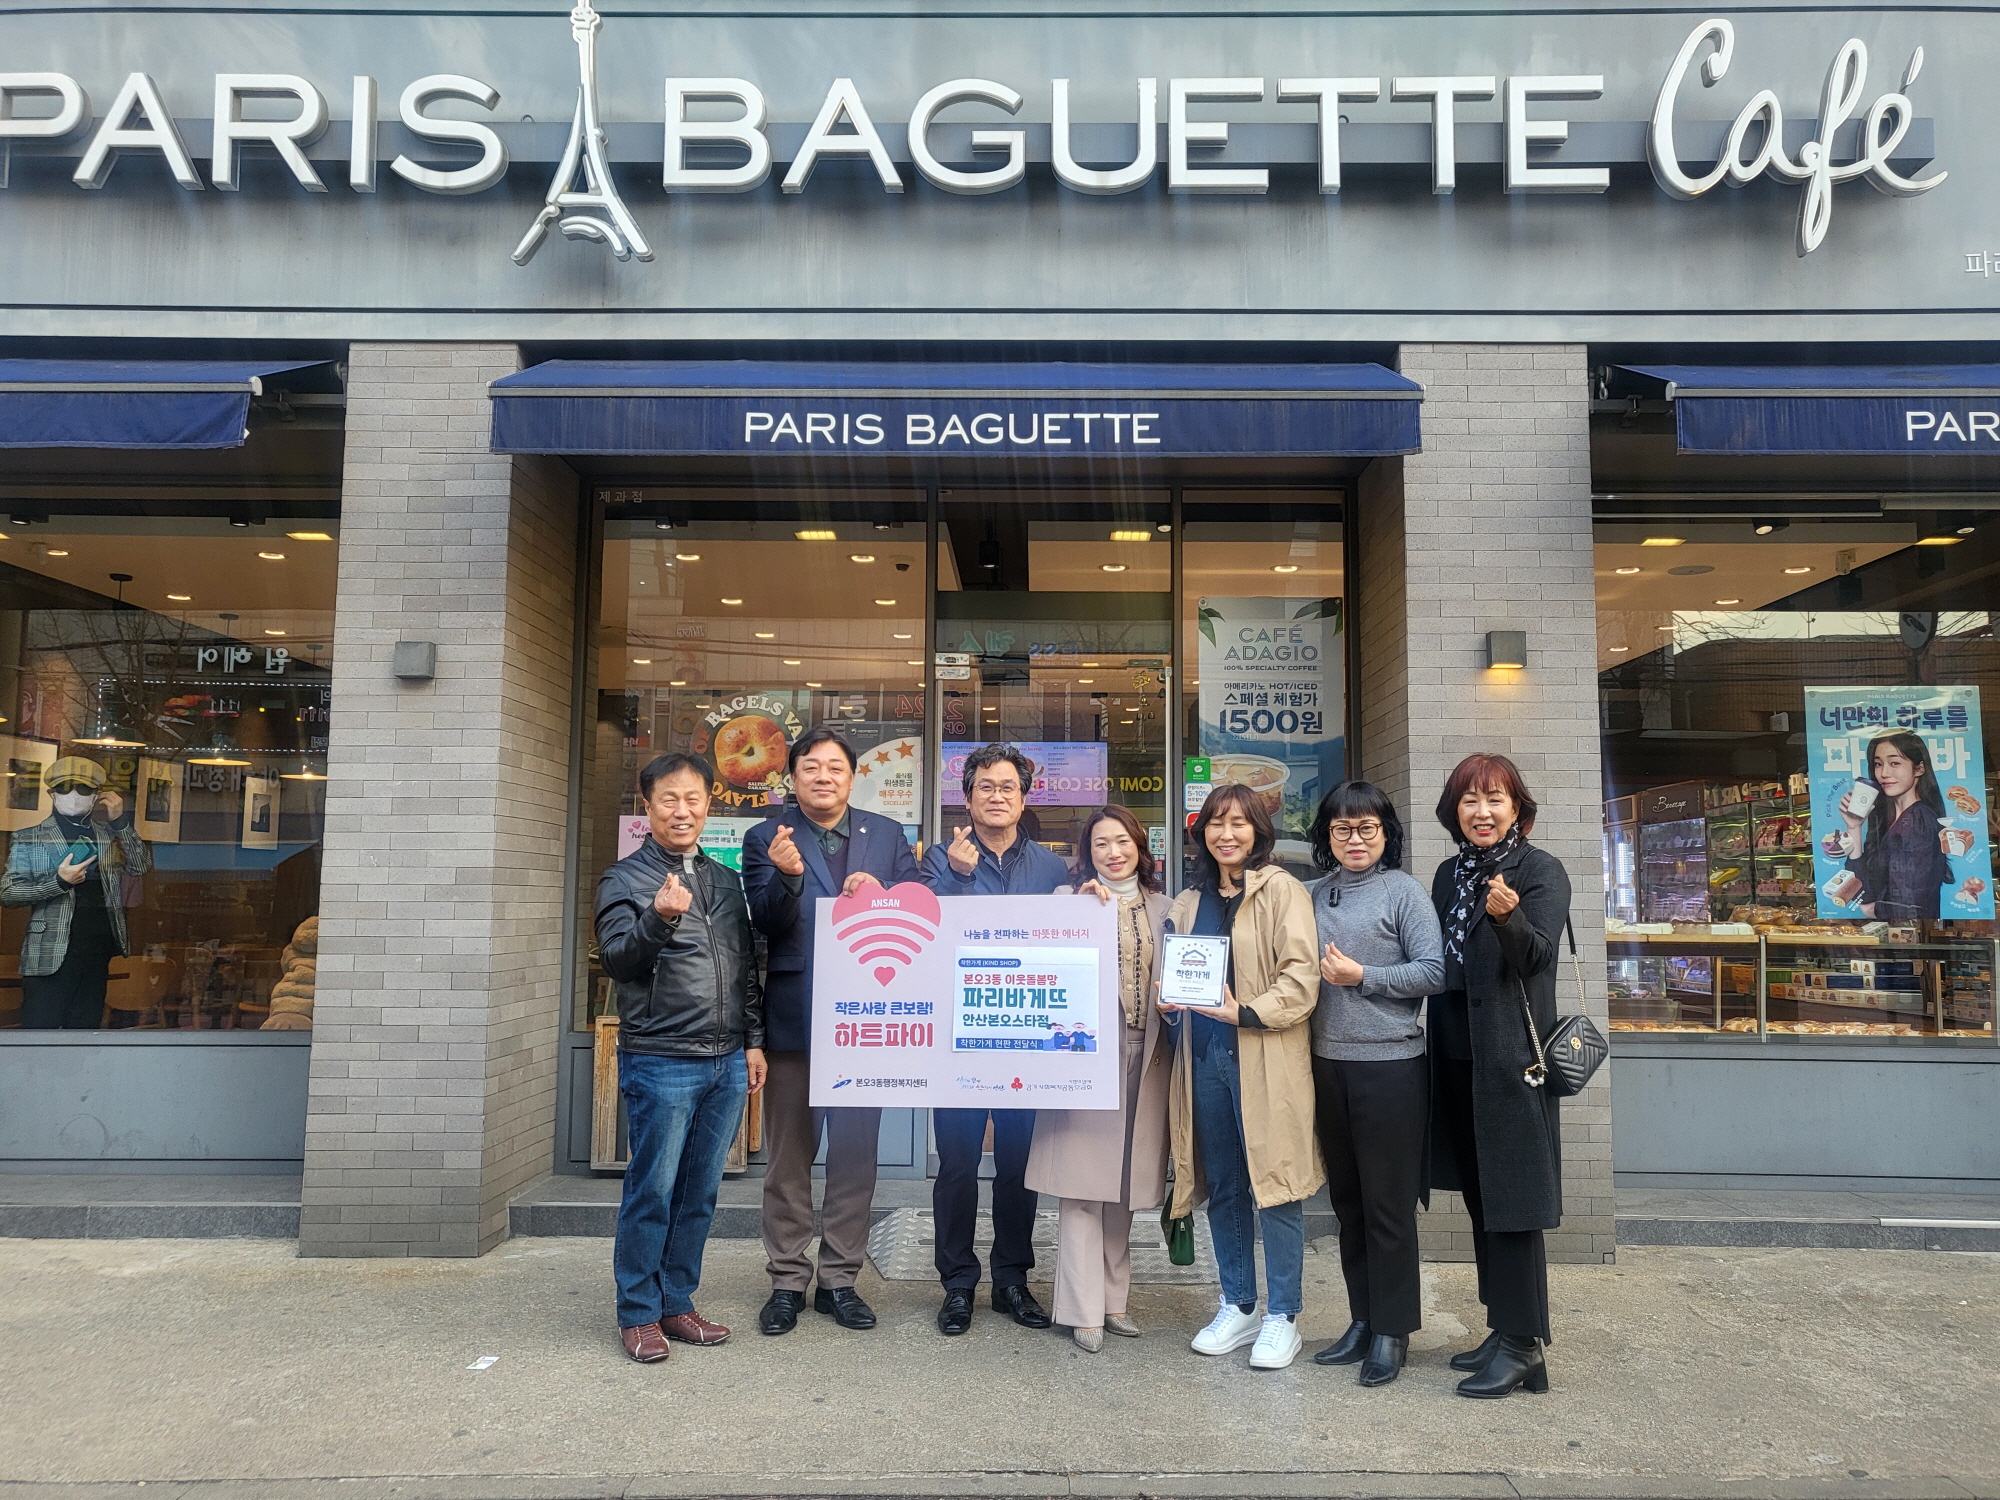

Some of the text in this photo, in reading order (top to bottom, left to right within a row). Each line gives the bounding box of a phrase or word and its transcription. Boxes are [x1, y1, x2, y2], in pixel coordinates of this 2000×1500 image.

[0, 17, 1949, 257] PARIS BAGUETTE Café
[743, 412, 1161, 445] PARIS BAGUETTE
[1906, 411, 2000, 442] PAR
[1238, 624, 1303, 643] CAFÉ
[1224, 645, 1319, 661] ADAGIO
[1224, 682, 1318, 691] 아메리카노 HOT/ICED
[1224, 692, 1318, 707] 스페셜 체험가
[704, 695, 784, 728] BAGELS
[1895, 705, 1969, 731] 하루를
[1219, 708, 1323, 735] 1500원
[878, 790, 913, 798] 매우 우수
[871, 898, 900, 908] ANSAN
[964, 928, 1090, 940] 나눔을 전파하는 따뜻한 에너지
[963, 973, 1058, 986] 본오3동 이웃돌봄망
[1176, 969, 1211, 980] 착한가게
[962, 987, 1068, 1009] 파리바게뜨
[834, 1001, 934, 1015] 작은사랑 큰보람!
[962, 1013, 1049, 1028] 안산본오스타점
[834, 1022, 934, 1048] 하트파이
[960, 1039, 1038, 1049] 착한가게 현판 전달식
[855, 1077, 928, 1089] 본오3동행정복지센터
